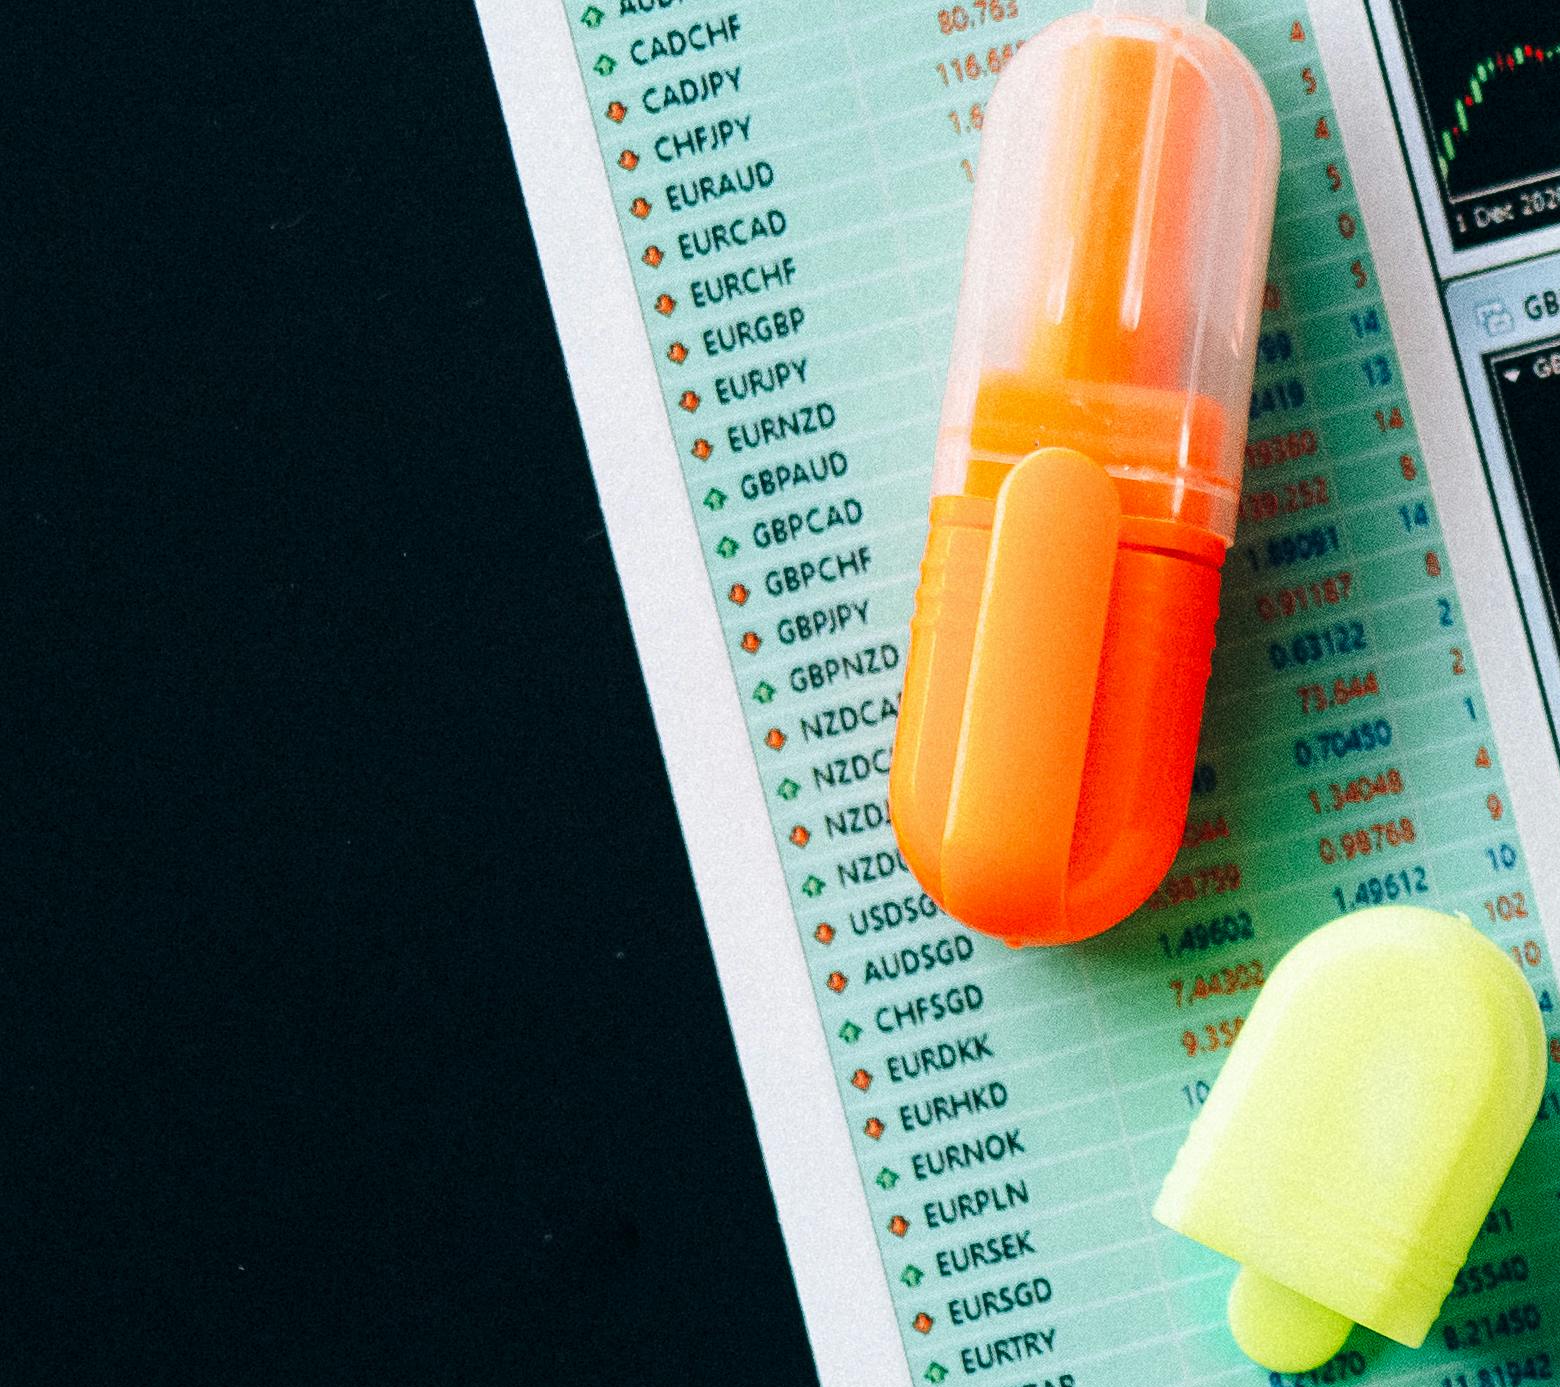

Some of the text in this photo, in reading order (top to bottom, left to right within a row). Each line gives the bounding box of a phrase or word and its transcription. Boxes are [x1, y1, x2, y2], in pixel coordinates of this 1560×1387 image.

[629, 14, 742, 66] CADCHF
[642, 66, 743, 116] CADJPY
[654, 114, 752, 163] CHFJPY
[665, 161, 775, 213] EURAUD
[678, 209, 787, 261] EURCAD
[1472, 202, 1516, 229] Dec
[690, 257, 798, 308] EURCHF
[702, 306, 806, 357] EURGBP
[714, 357, 809, 406] EURJPY
[727, 401, 837, 455] EURNZD
[740, 450, 849, 503] GBPAUD
[752, 499, 863, 551] GBPCAD
[764, 546, 873, 598] GBPCHF
[777, 598, 871, 647] GBPJPY
[1436, 597, 1454, 628] 2
[789, 643, 900, 696] GBPNZD
[1449, 646, 1466, 676] 2
[800, 693, 902, 745] NZDCA
[812, 747, 890, 793] NZDC
[1475, 745, 1493, 770] 4
[1331, 865, 1430, 913] 1.49612
[1483, 842, 1518, 874] 10
[849, 892, 940, 939] USDSG
[1482, 890, 1531, 925] 102
[864, 933, 975, 985] AUDSGD
[875, 983, 985, 1035] CHFSGD
[886, 1032, 994, 1084] EURDKK
[899, 1081, 1009, 1133] EURHKD
[911, 1127, 1026, 1182] EURNOK
[923, 1178, 1030, 1230] EURPLN
[935, 1229, 1037, 1279] EURSEK
[947, 1276, 1054, 1327] EURSGD
[960, 1328, 1056, 1376] EURTRY
